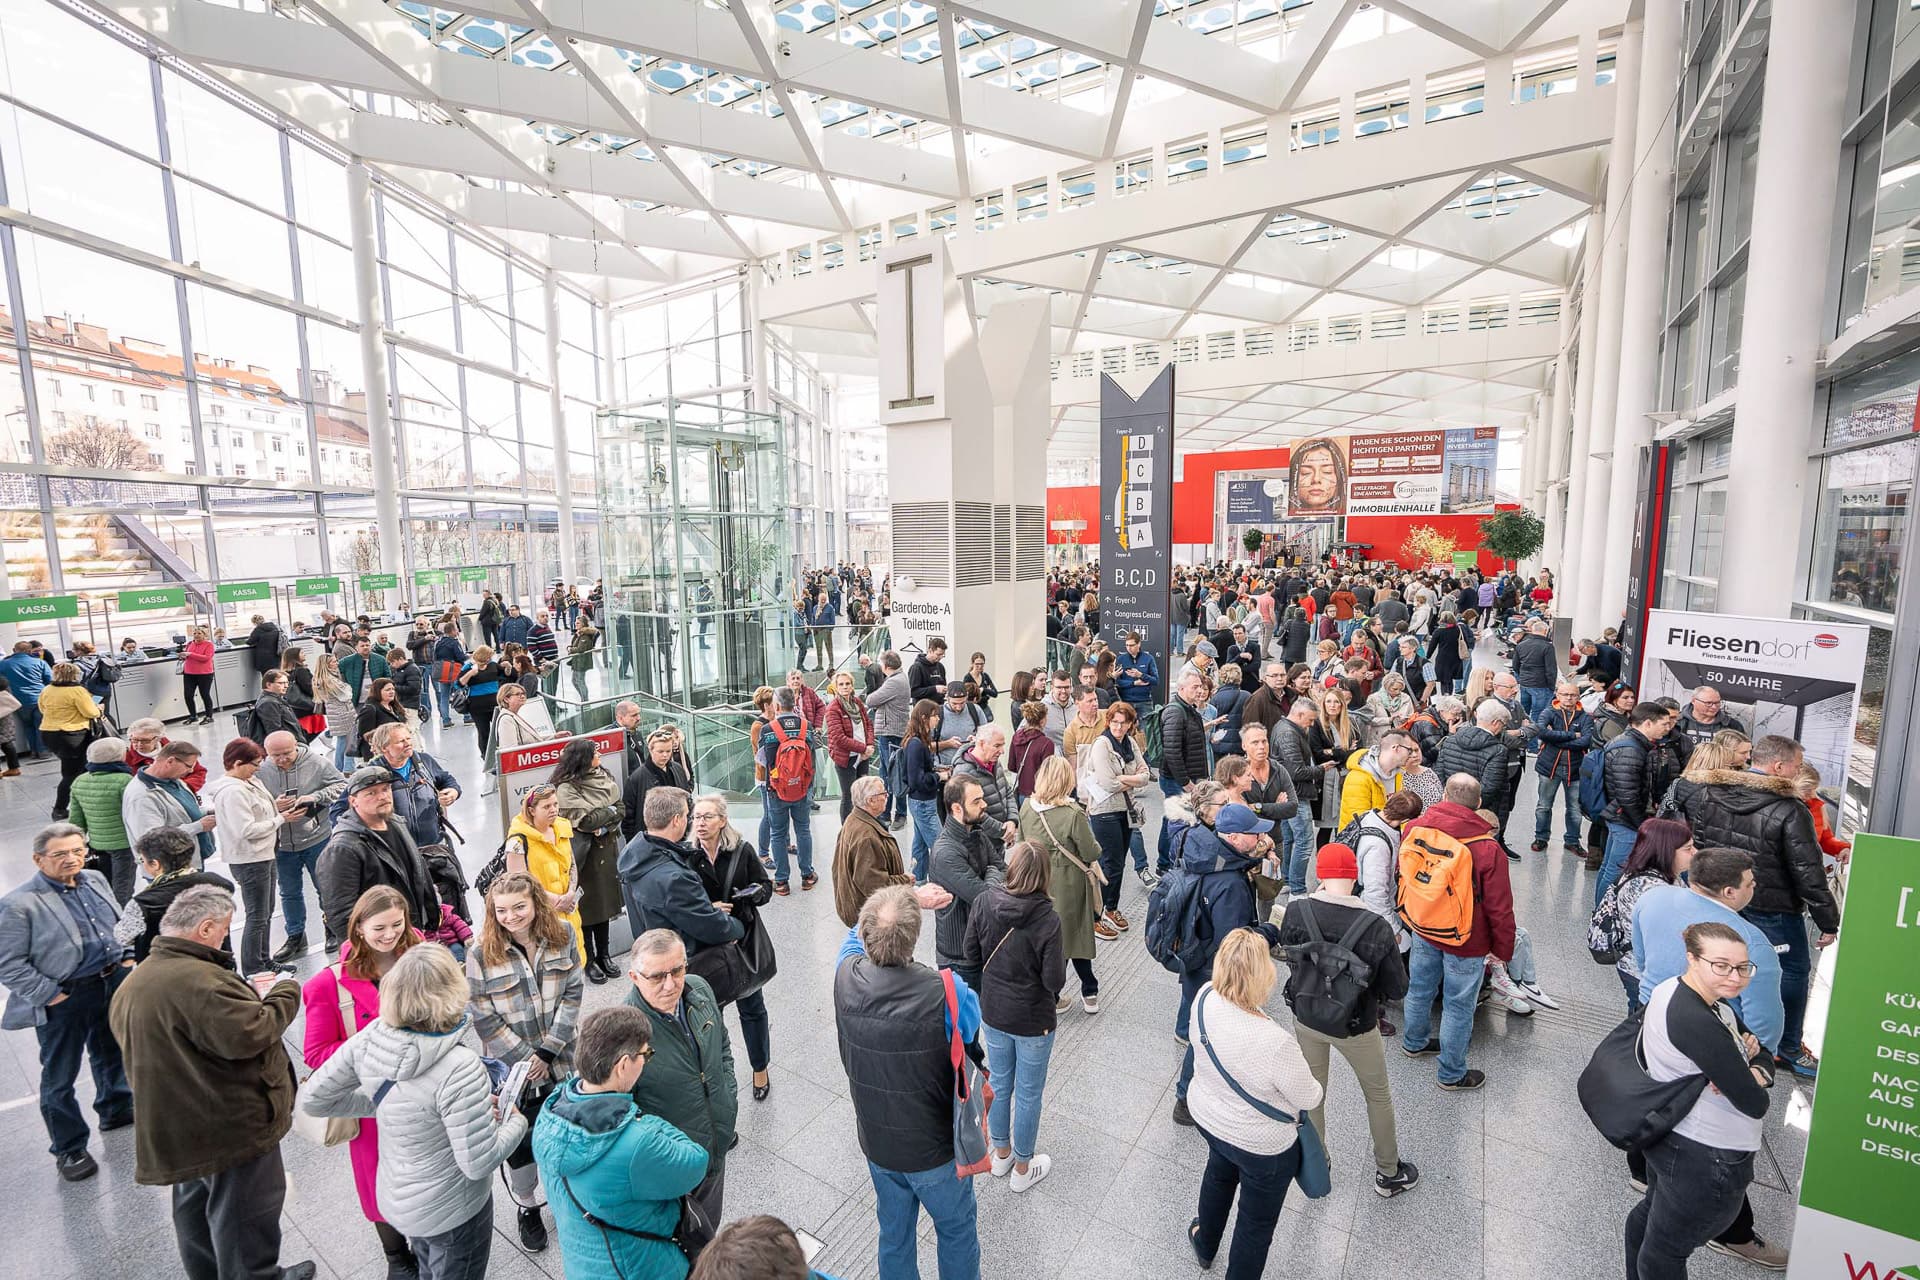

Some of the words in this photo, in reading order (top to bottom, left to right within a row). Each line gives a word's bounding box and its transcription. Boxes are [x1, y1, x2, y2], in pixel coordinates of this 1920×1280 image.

[1138, 436, 1146, 450] D
[1352, 438, 1380, 446] HABEN
[1380, 437, 1393, 445] SIE
[1393, 435, 1422, 444] SCHON
[1423, 434, 1441, 442] DEN
[1447, 442, 1488, 450] INVESTMENT
[1352, 446, 1394, 455] RICHTIGEN
[1394, 443, 1436, 453] PARTNER?
[1137, 464, 1144, 478] C
[1398, 485, 1438, 496] Ringsmuth
[1136, 497, 1144, 511] B
[1350, 503, 1436, 514] IMMOBILIENHALLE
[1634, 501, 1644, 549] A
[1137, 529, 1144, 542] A
[1115, 568, 1156, 588] B,C,D
[308, 582, 329, 591] KASSA
[232, 589, 257, 598] KASSA
[138, 595, 169, 605] KASSA
[1115, 596, 1137, 606] Foyer-D
[17, 604, 56, 615] KASSA
[1115, 609, 1142, 619] Congress
[1142, 611, 1162, 619] Center
[901, 617, 941, 631] Toiletten
[1667, 627, 1813, 660] Fliesendorf
[1701, 652, 1726, 660] Fliesen
[1733, 655, 1759, 664] Sanitär
[1705, 671, 1724, 683] 50
[1727, 674, 1783, 692] JAHRE
[1872, 1071, 1920, 1093] NAC
[1869, 1088, 1915, 1109] AUS
